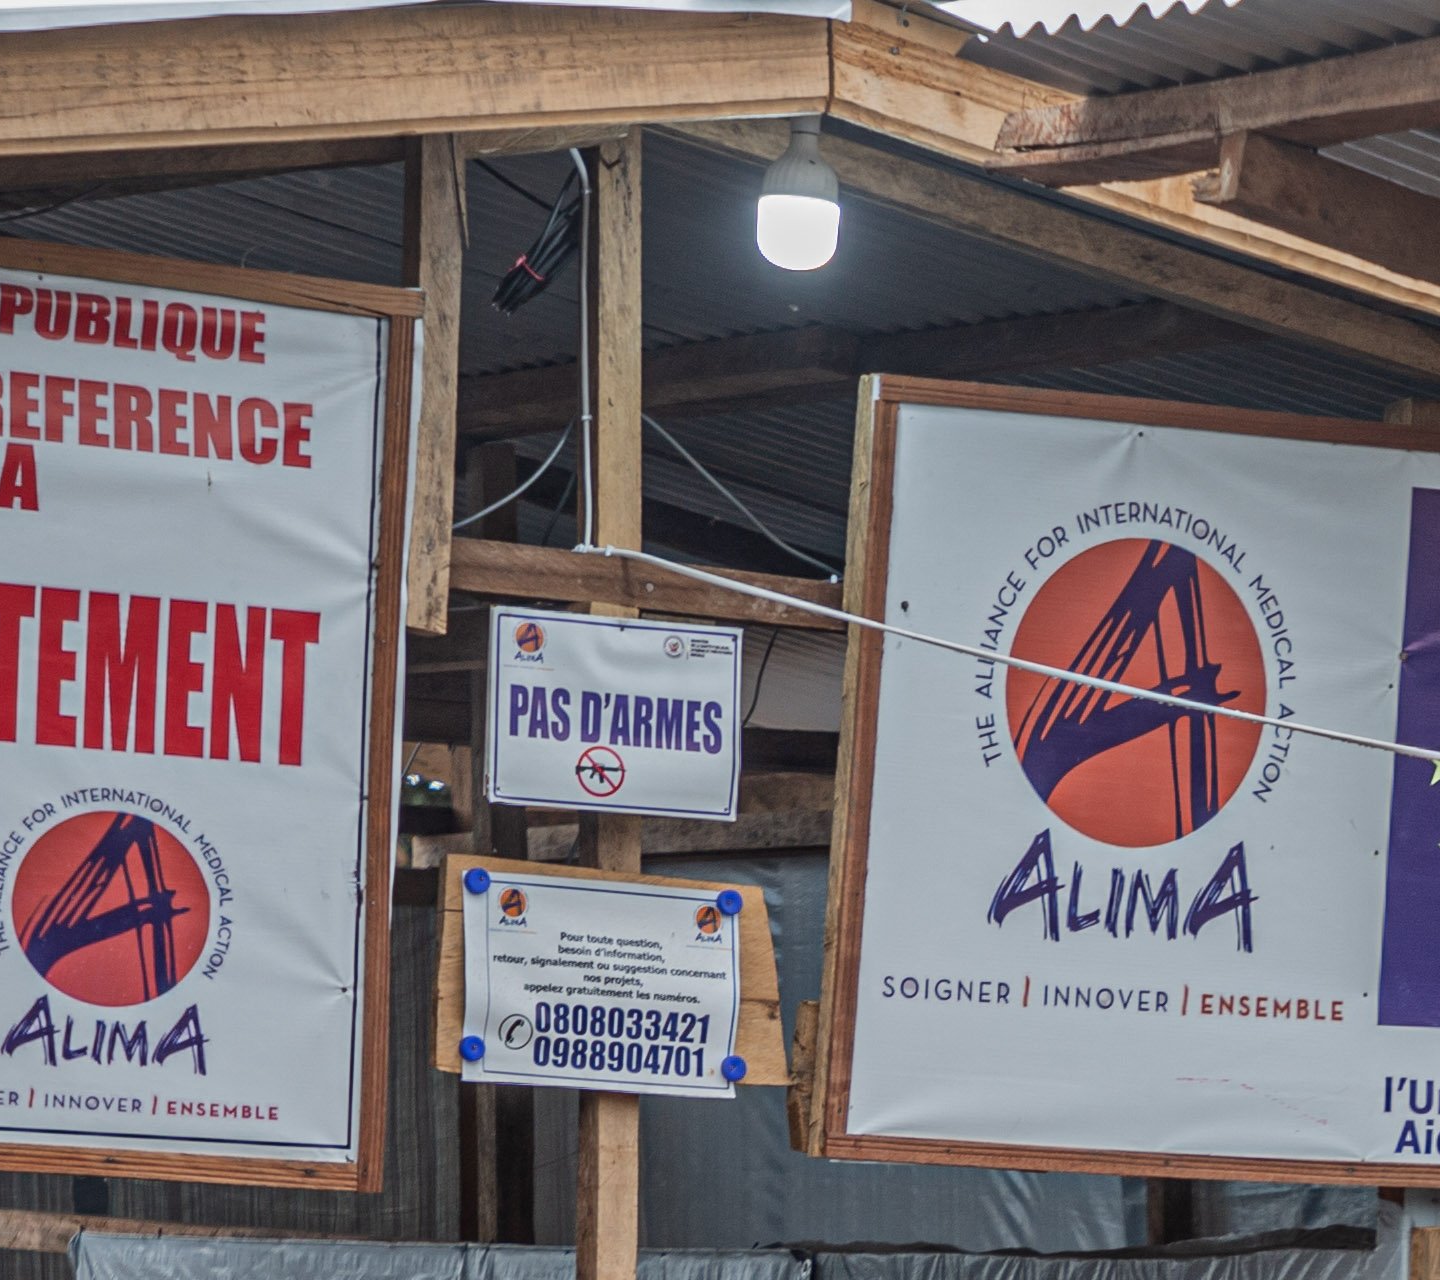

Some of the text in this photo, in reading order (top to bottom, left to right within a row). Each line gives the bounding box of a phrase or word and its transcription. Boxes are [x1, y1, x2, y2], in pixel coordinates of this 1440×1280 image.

[974, 501, 1299, 805] THE ALLIANCE FOR INTERNATIONAL MEDICAL ACTION
[509, 683, 724, 756] PAS D'ARMES
[22, 800, 57, 834] FOR
[59, 787, 192, 836] INTERNATIONAL
[194, 832, 236, 909] MEDICAL
[986, 828, 1260, 955] ALIMA
[200, 914, 235, 982] ACTION
[558, 945, 591, 958] besoin
[560, 931, 584, 946] Pour
[587, 933, 613, 947] toute
[492, 954, 727, 981] retour, signalement ou suggestion concernant
[583, 973, 644, 988] nos projets,
[523, 983, 563, 998] appelez
[566, 985, 633, 1001] gratuitement
[636, 989, 651, 1001] les
[882, 975, 1345, 1022] SOIGNER INNOVER ENSEMBLE
[0, 992, 211, 1077] ALIMA
[534, 1001, 710, 1045] 0808033421
[532, 1035, 705, 1079] 0988904701
[43, 1092, 143, 1115] INNOVER
[165, 1099, 281, 1122] ENSEMBLE
